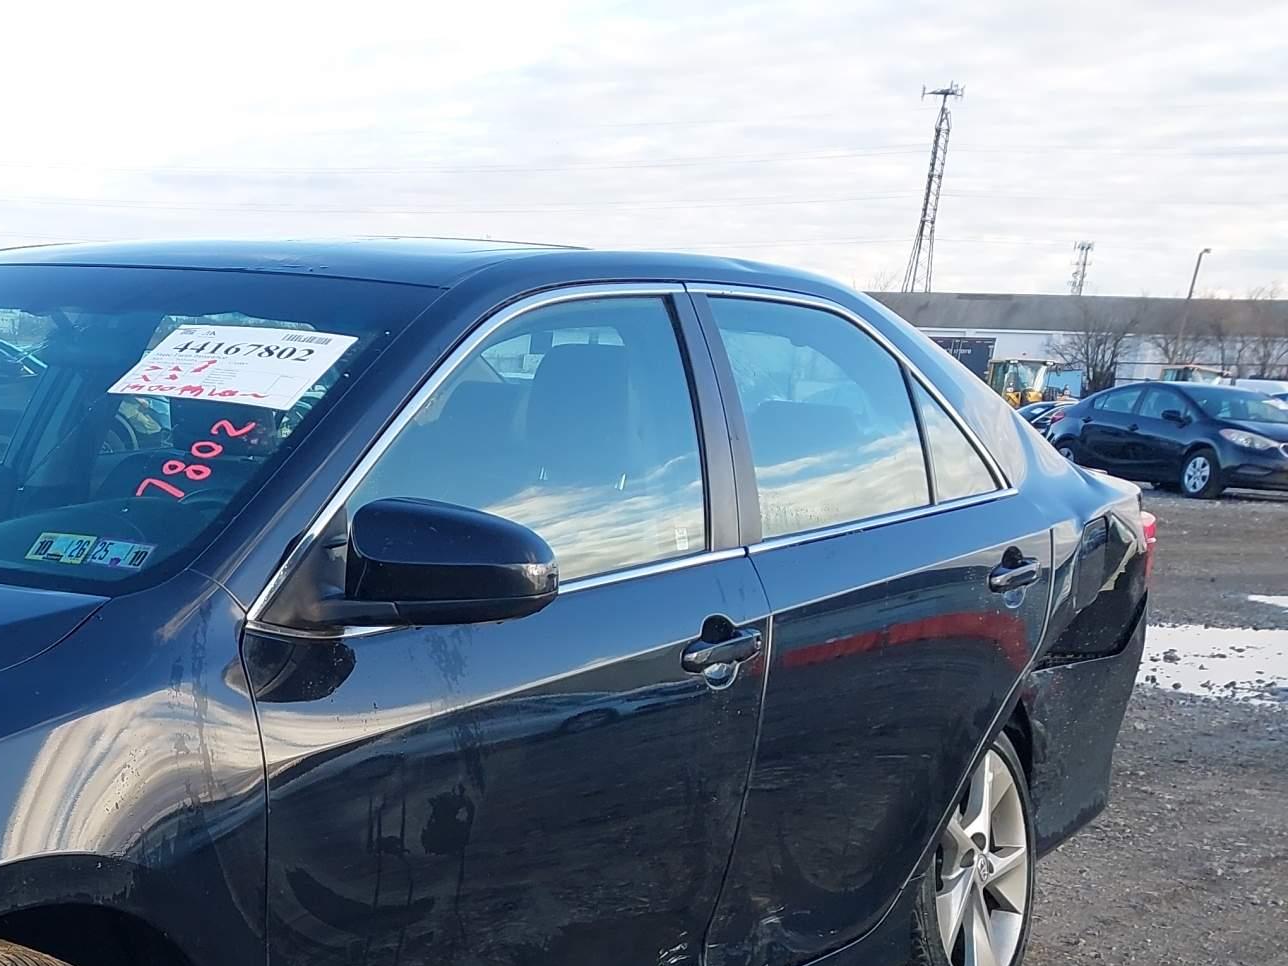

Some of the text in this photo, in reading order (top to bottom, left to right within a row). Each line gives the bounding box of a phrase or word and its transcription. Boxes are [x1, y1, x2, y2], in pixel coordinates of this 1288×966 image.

[172, 340, 315, 362] 44167802
[135, 419, 257, 499] 7802
[35, 540, 91, 558] 10 26
[92, 542, 114, 560] 25
